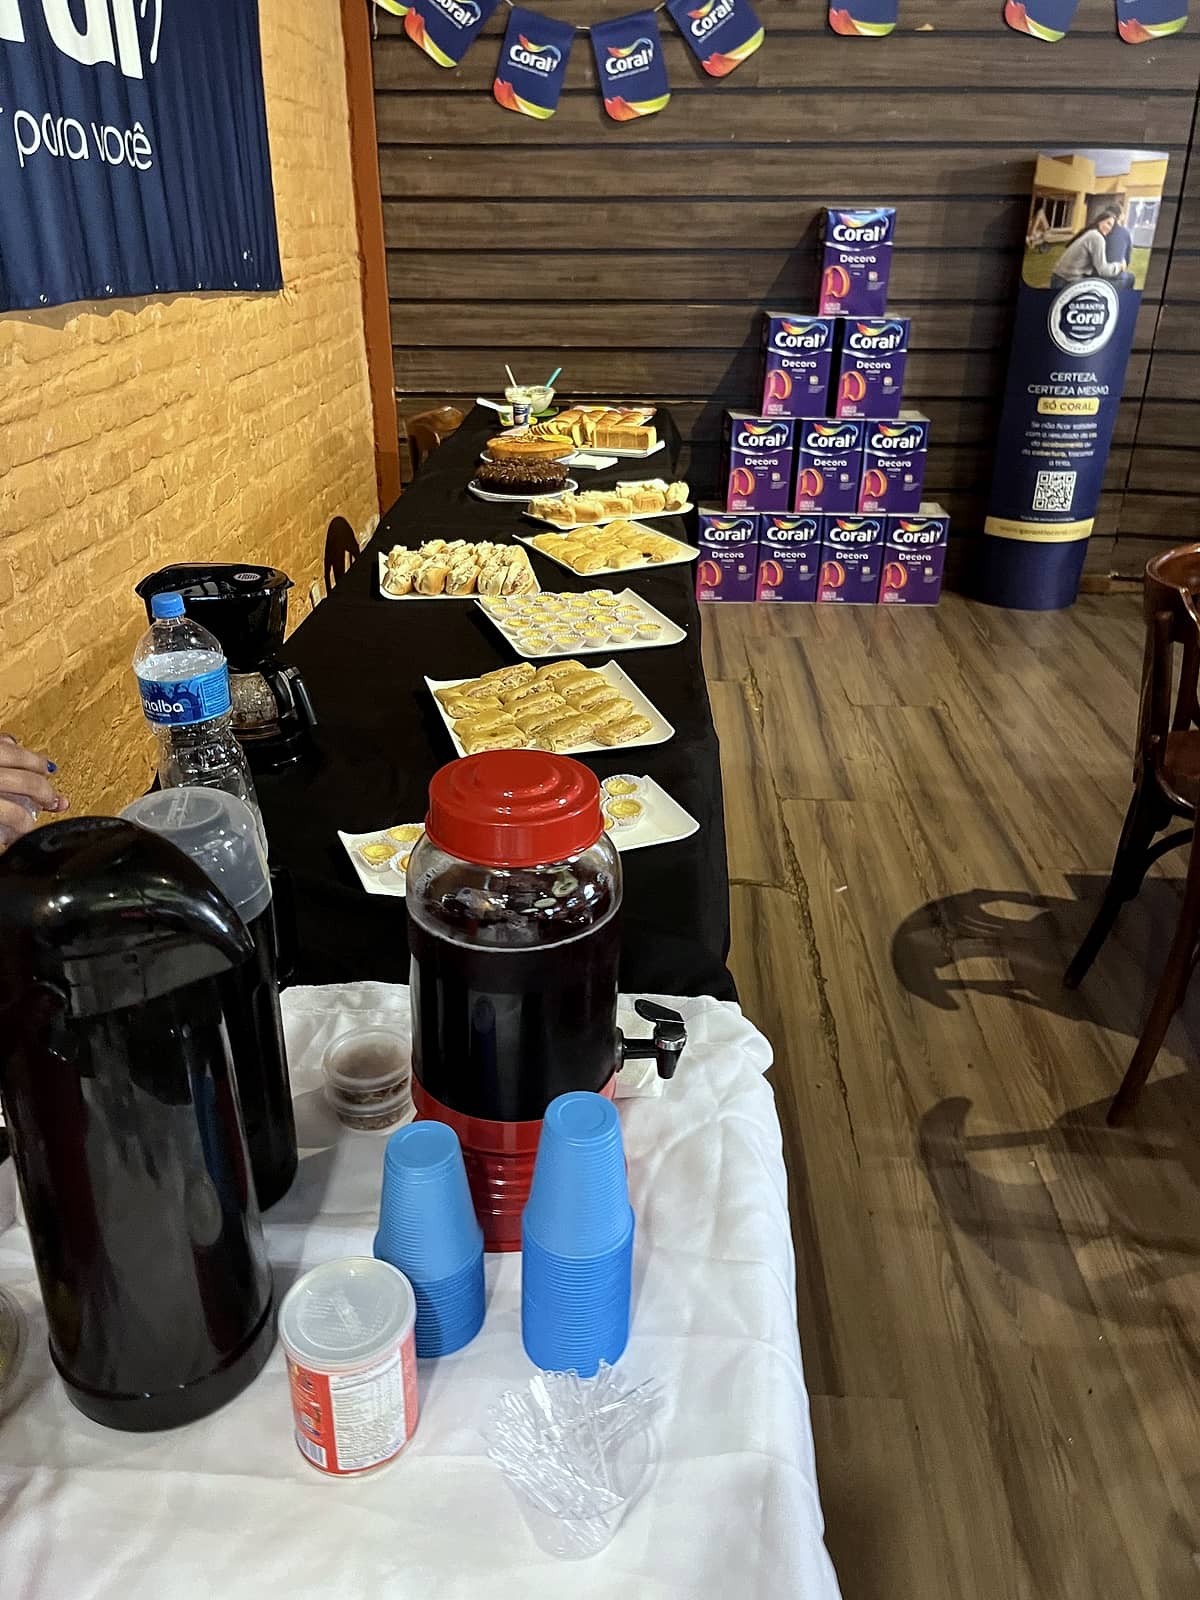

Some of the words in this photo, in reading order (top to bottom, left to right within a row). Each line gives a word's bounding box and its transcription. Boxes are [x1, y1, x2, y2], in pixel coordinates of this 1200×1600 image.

[690, 0, 734, 37] Coral
[509, 44, 553, 72] Coral
[605, 49, 649, 75] Coral
[14, 110, 89, 168] para
[91, 122, 153, 170] você
[833, 225, 880, 242] Coral
[840, 254, 877, 263] Decora
[1066, 310, 1105, 325] Coral
[774, 331, 820, 348] Coral
[849, 332, 894, 350] Coral
[781, 359, 817, 368] Decora
[856, 360, 892, 369] Decora
[1027, 384, 1075, 395] CERTEZA
[1076, 385, 1109, 395] MESMO
[1042, 400, 1057, 411] SÓ
[1059, 402, 1094, 411] CORAL
[737, 432, 781, 447] Coral
[806, 433, 851, 448] Coral
[871, 434, 915, 449] Coral
[744, 457, 779, 466] Decora
[813, 458, 848, 467] Decora
[877, 459, 912, 468] Decora
[704, 527, 747, 541] Coral
[766, 527, 809, 542] Coral
[829, 527, 873, 543] Coral
[892, 529, 935, 544] Coral
[711, 551, 745, 559] Decora
[773, 551, 807, 559] Decora
[835, 552, 869, 560] Decora
[898, 553, 932, 561] Decora
